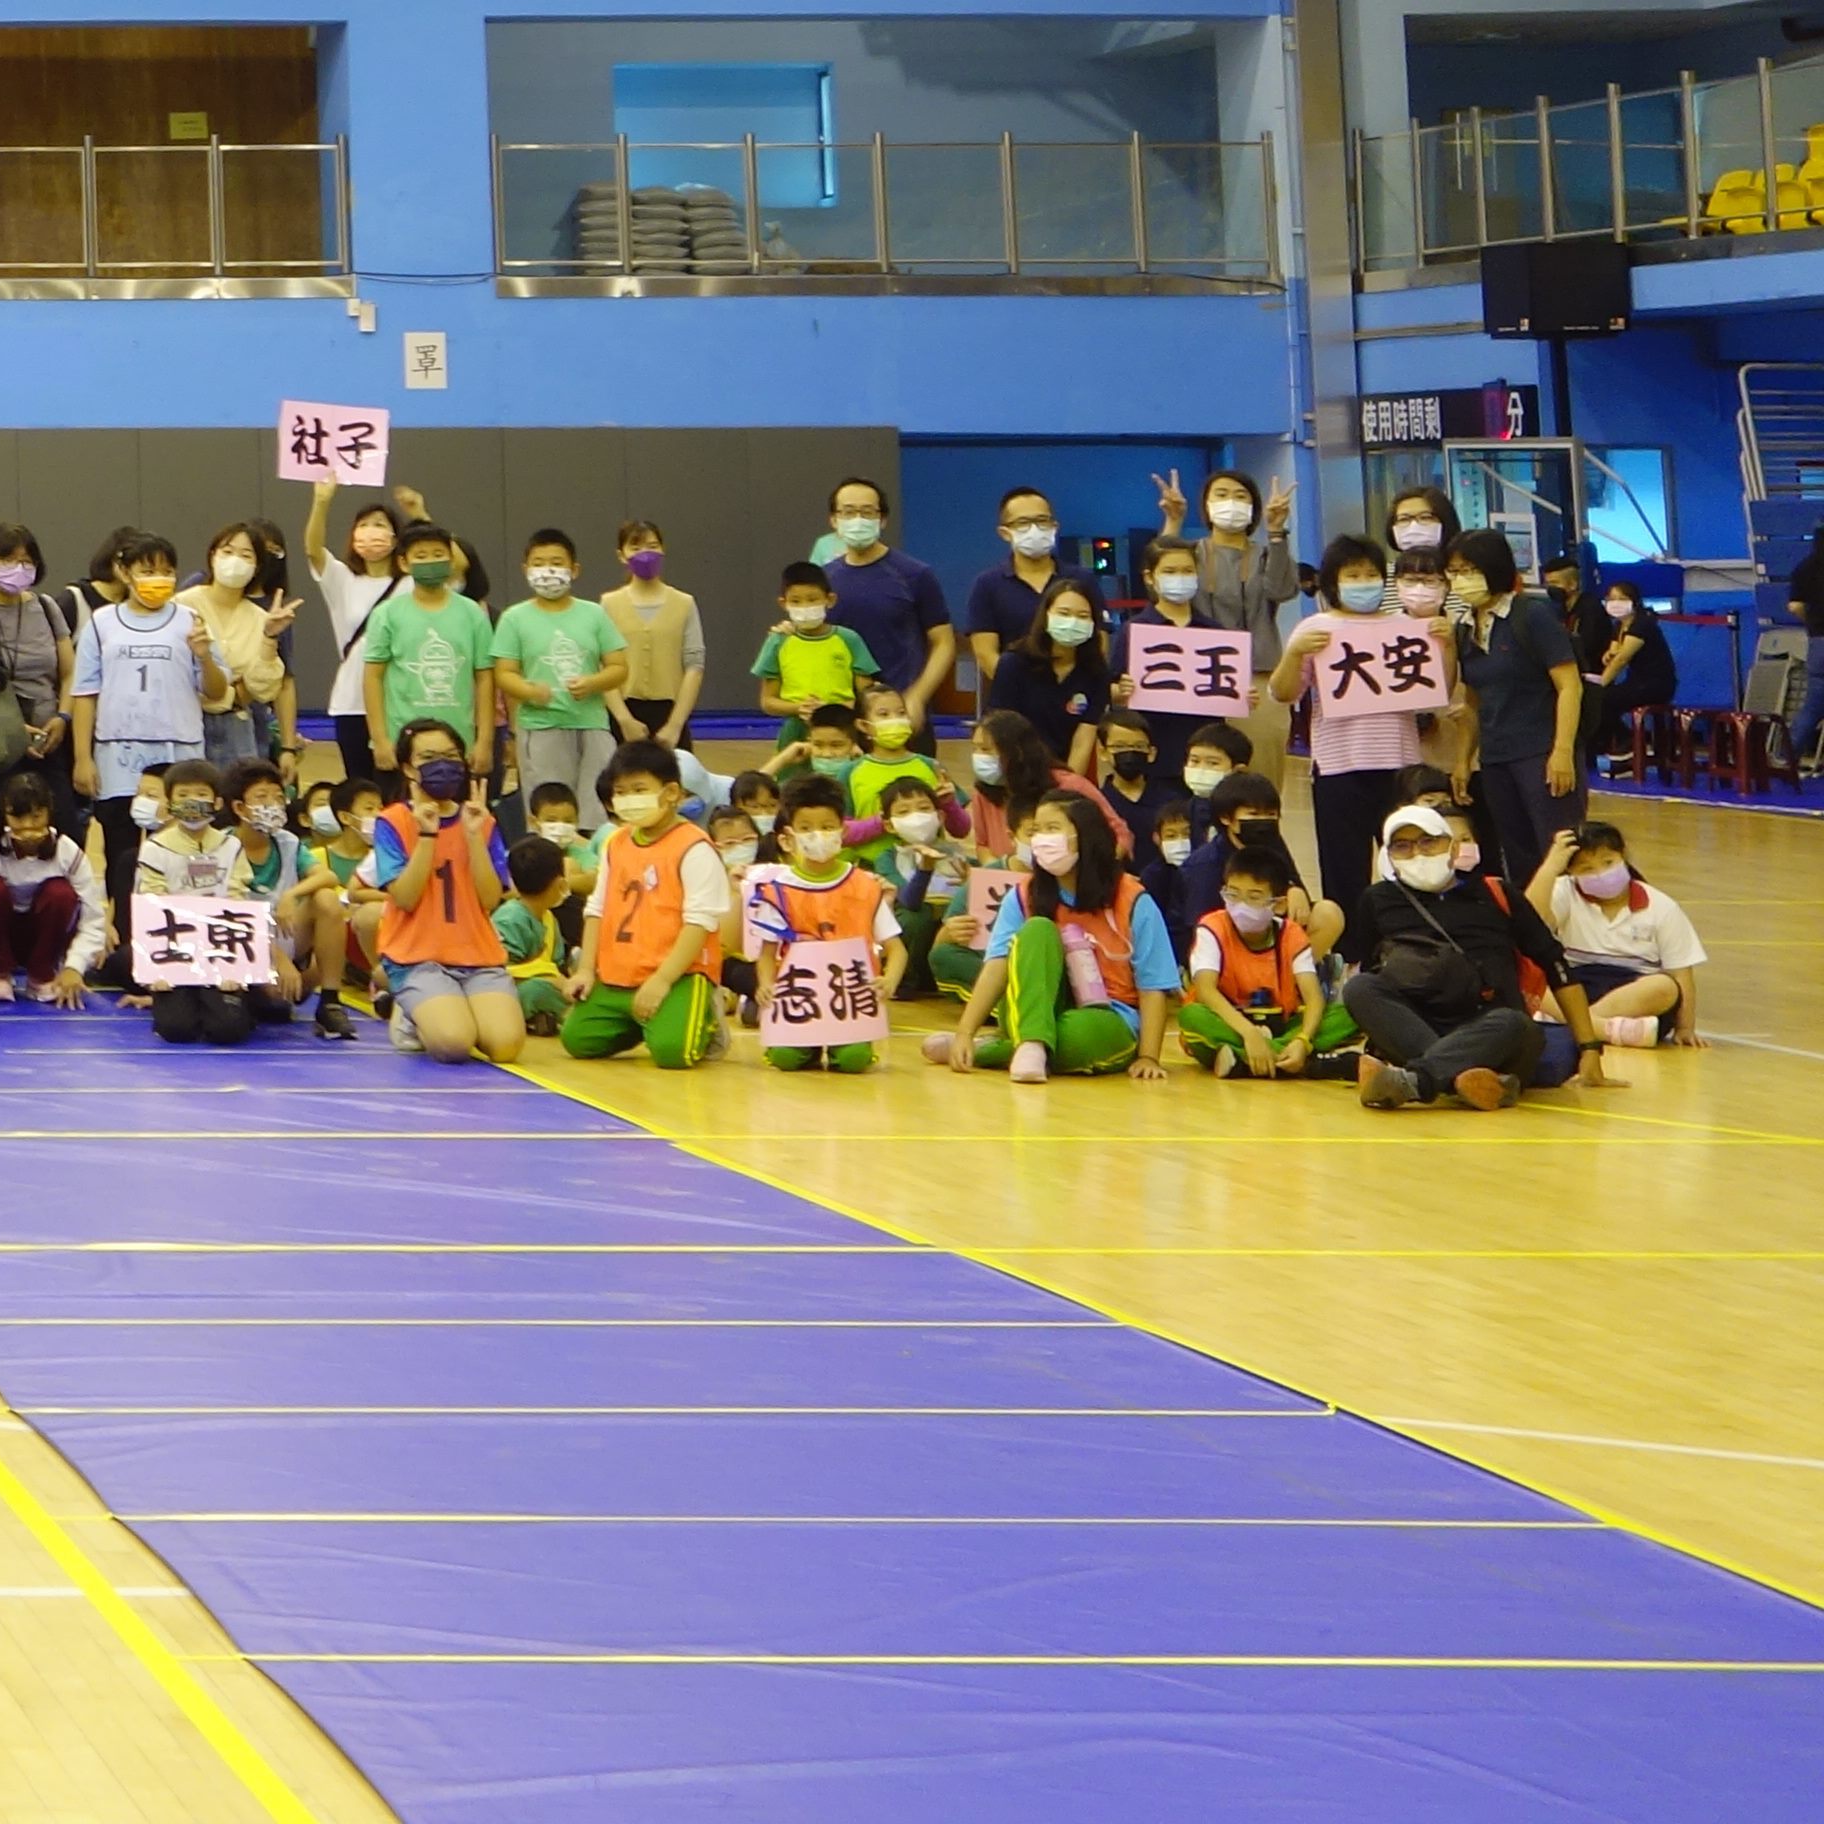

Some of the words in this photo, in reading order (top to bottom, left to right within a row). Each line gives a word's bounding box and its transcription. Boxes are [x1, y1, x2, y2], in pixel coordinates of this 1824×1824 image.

[411, 344, 443, 380] 罩
[291, 414, 378, 470] 社子
[1362, 395, 1442, 443] 使用時間剩
[1506, 391, 1525, 438] 分
[136, 663, 149, 693] 1
[1140, 643, 1241, 700] 三玉
[1329, 635, 1437, 700] 大安
[435, 859, 457, 924] 1
[615, 879, 645, 944] 2
[145, 907, 257, 965] 士東
[770, 959, 879, 1026] 志清
